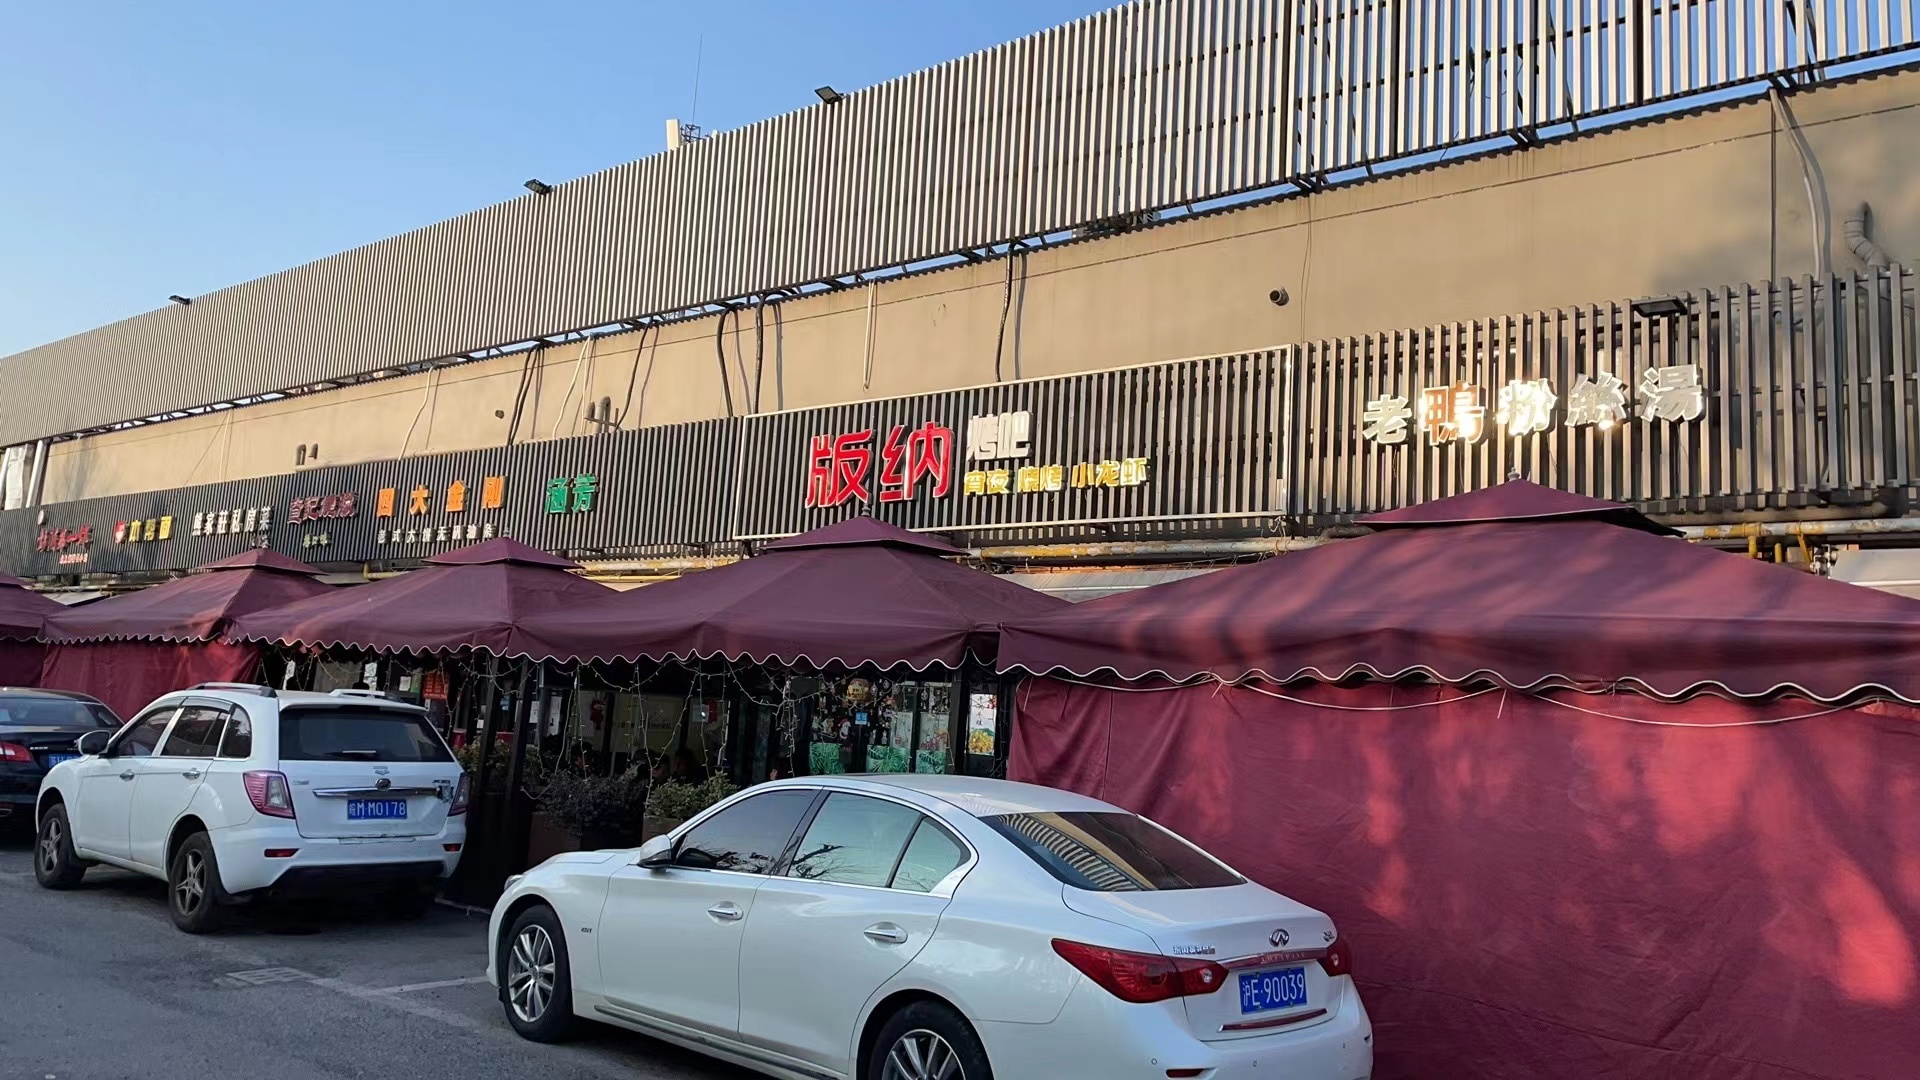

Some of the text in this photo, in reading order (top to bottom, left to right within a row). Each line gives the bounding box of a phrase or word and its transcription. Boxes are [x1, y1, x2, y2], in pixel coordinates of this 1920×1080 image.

[966, 411, 1035, 462] 烤吧
[805, 421, 953, 508] 版纳
[963, 457, 1147, 496] 宵夜 烧烤 小龙虾
[376, 475, 505, 517] 四大金刚
[129, 515, 173, 542] 本帮面
